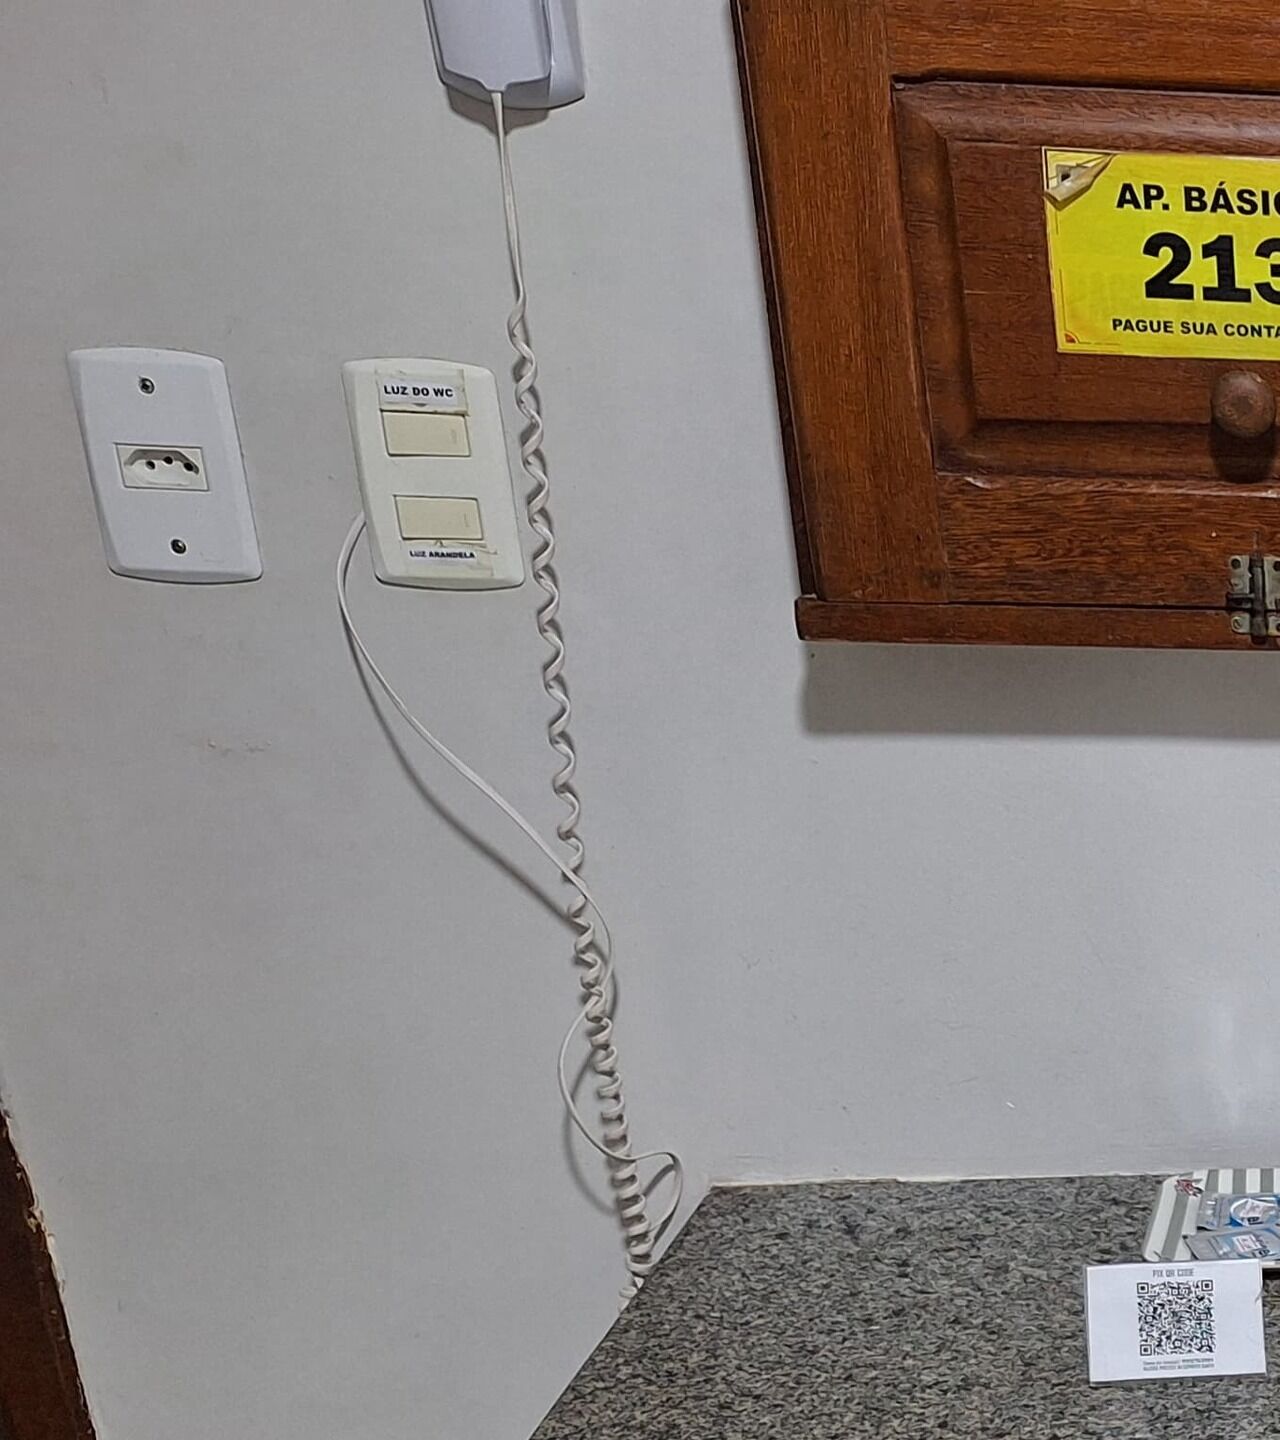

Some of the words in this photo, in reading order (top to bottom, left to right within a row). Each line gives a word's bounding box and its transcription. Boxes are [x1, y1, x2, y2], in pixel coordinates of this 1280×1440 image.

[1115, 182, 1171, 211] AP.
[1111, 318, 1175, 335] PAGUE
[1180, 321, 1219, 336] SUA
[383, 384, 409, 396] LUZ
[412, 386, 430, 397] DO
[432, 387, 454, 398] WC
